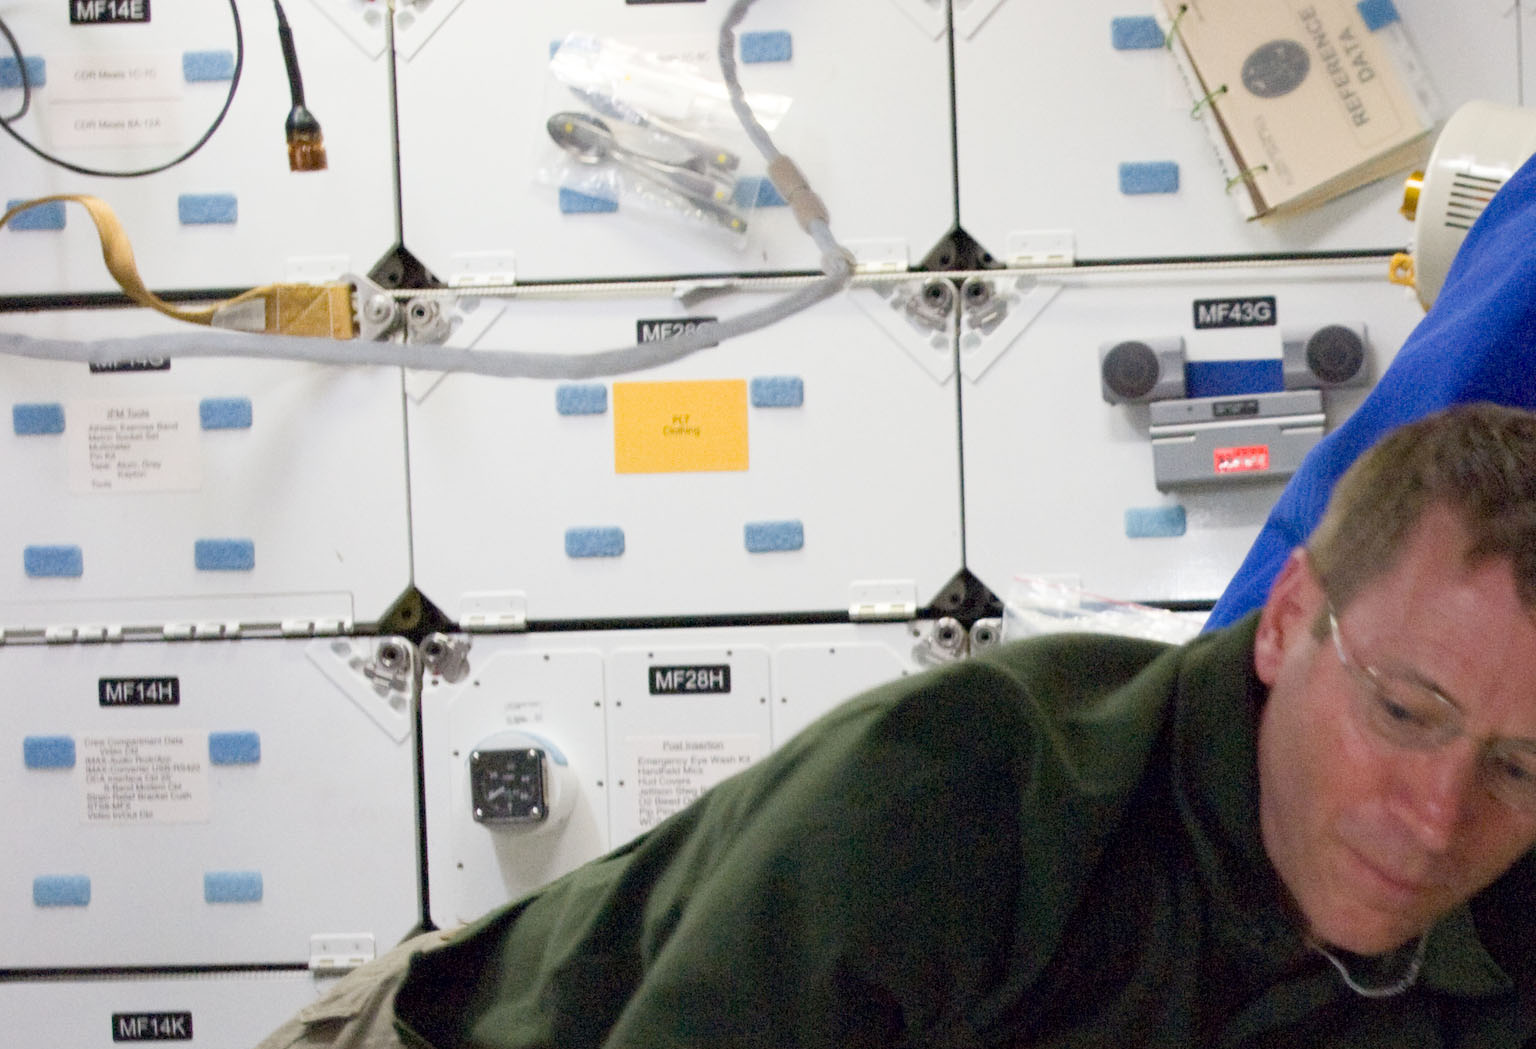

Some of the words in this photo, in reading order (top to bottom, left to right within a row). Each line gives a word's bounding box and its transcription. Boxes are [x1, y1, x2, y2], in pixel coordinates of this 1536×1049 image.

[76, 0, 144, 20] MF14E
[1296, 3, 1371, 128] REFERENCE
[1337, 24, 1378, 86] DATA
[1197, 301, 1272, 324] MF43G
[654, 668, 725, 690] MF28H
[105, 681, 173, 702] MF14H
[119, 1015, 187, 1037] MF14K
